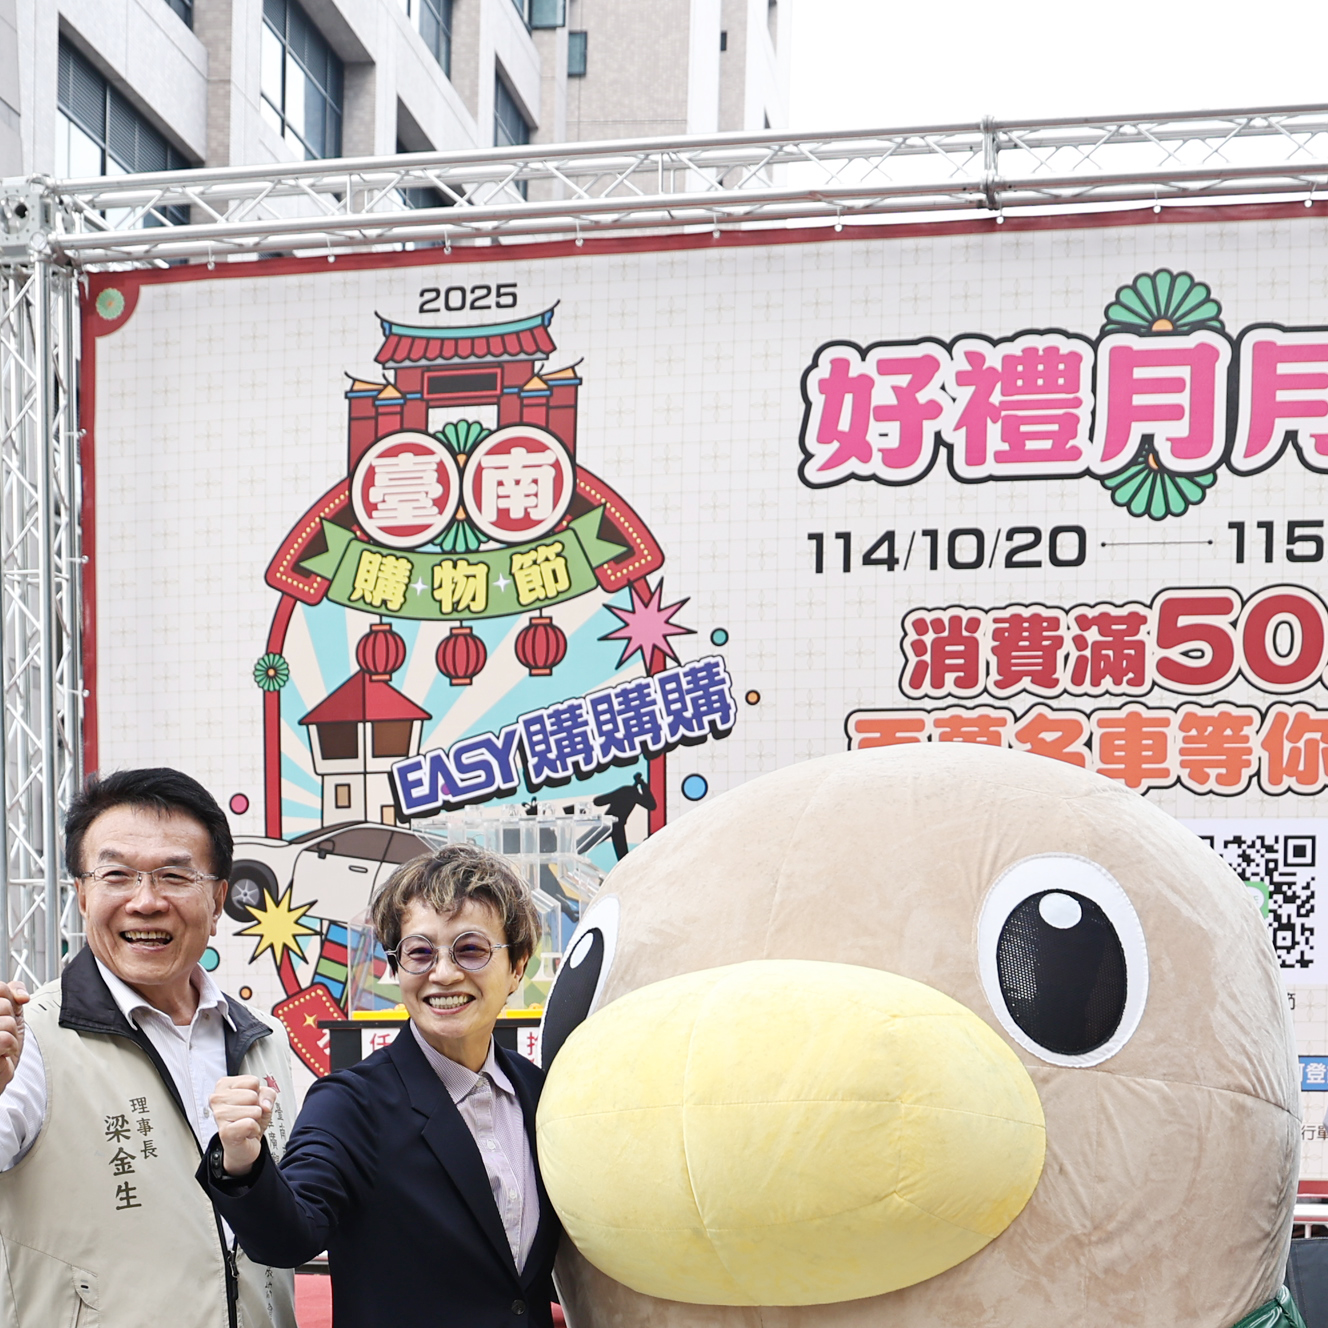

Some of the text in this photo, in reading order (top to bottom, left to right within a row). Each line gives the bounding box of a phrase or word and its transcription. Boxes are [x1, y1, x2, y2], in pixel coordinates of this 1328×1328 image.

[418, 283, 519, 314] 2025
[368, 447, 558, 529] 臺南
[350, 541, 572, 614] 購物節
[806, 524, 1088, 574] 114/10/20
[129, 1096, 159, 1160] 理事長
[104, 1114, 142, 1211] 梁金生
